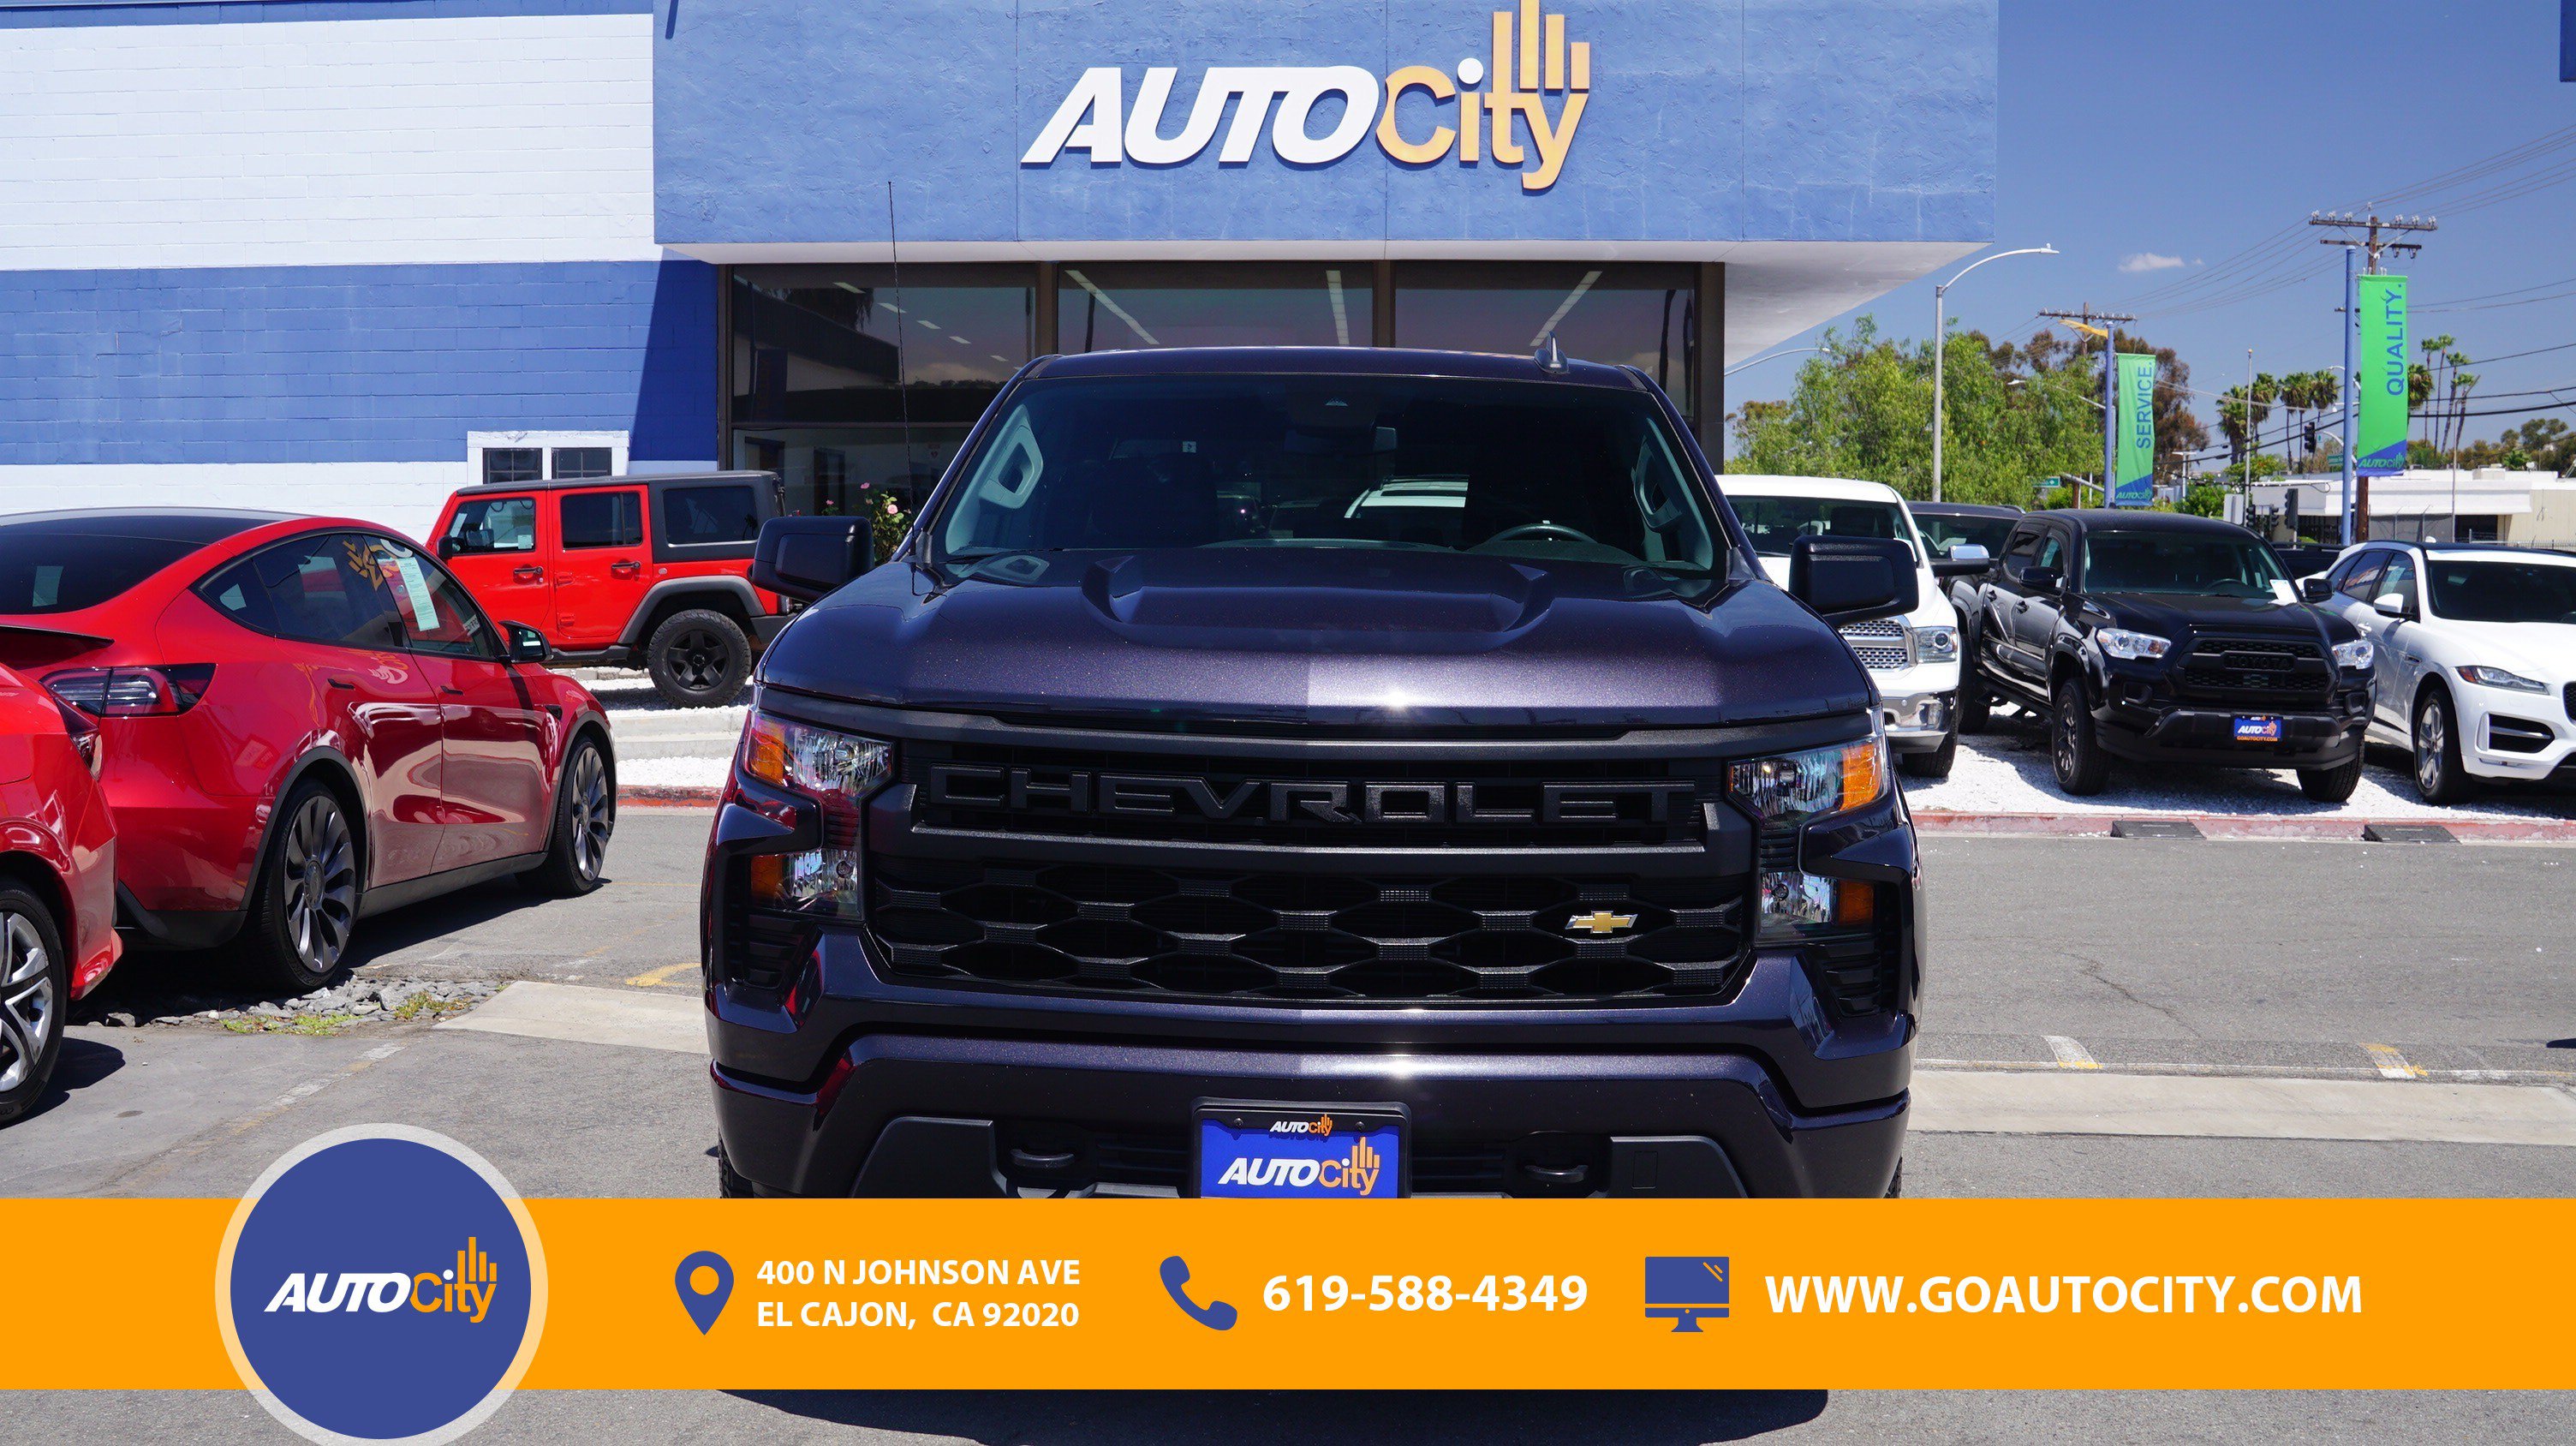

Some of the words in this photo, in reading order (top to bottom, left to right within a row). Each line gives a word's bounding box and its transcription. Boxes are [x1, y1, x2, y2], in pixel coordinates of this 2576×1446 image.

[2385, 284, 2406, 396] QUALITY.
[2136, 362, 2153, 449] SERVICE.
[929, 763, 1696, 826] CHEVROLET
